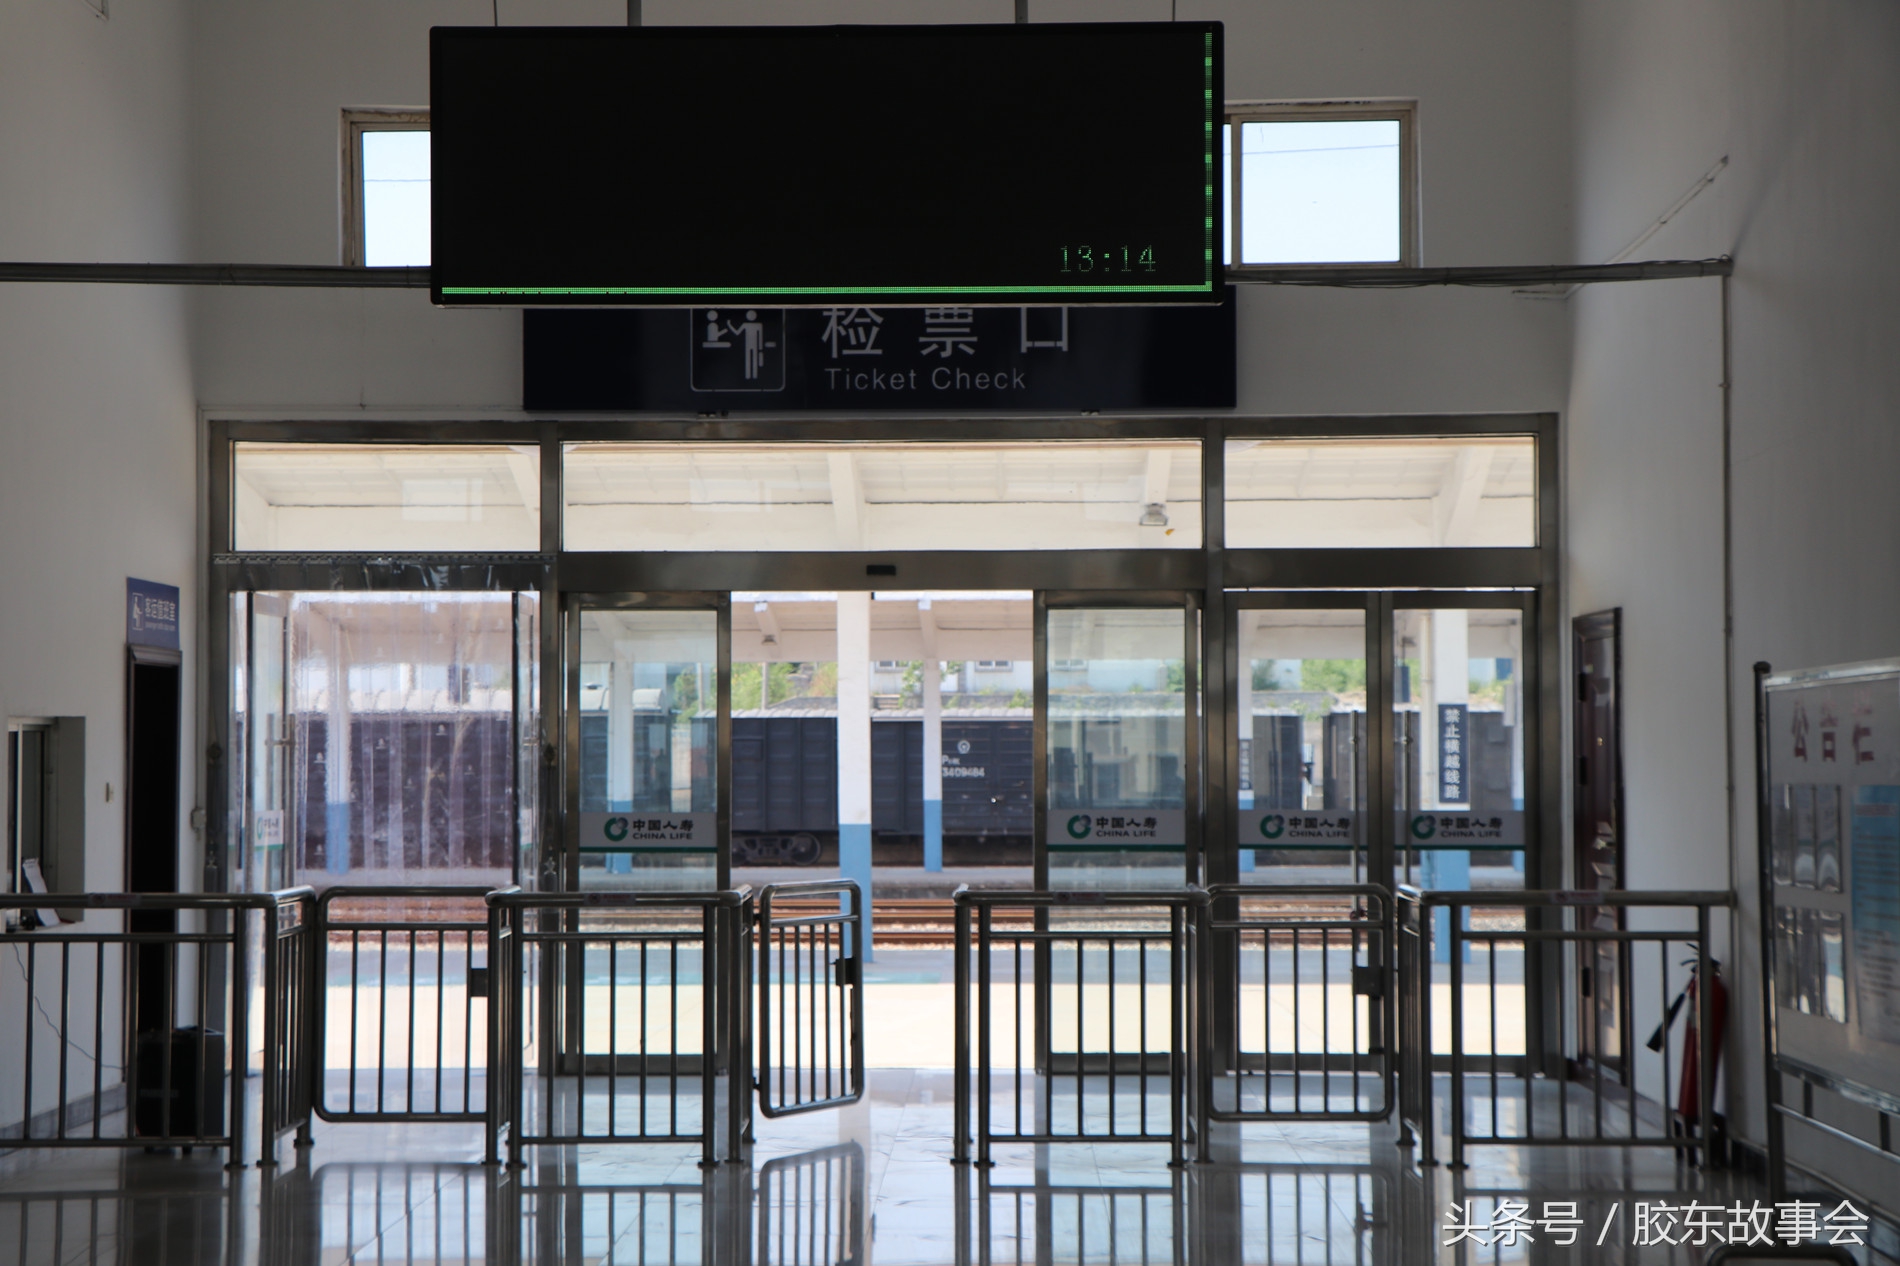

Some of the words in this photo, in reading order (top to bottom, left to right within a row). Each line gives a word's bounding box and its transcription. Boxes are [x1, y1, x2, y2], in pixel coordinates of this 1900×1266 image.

[1059, 244, 1157, 272] 13:14
[821, 307, 1069, 359] 检票口
[825, 366, 918, 391] Ticket
[931, 366, 1027, 391] Check
[1444, 708, 1461, 800] 禁止横越线路
[632, 819, 694, 831] 中国人寿
[1096, 816, 1158, 829] 中国人寿
[1288, 817, 1351, 829] 中国人寿
[1440, 817, 1503, 829] 中国人寿
[632, 832, 666, 840] CHINA
[669, 832, 693, 840] LIFE
[1096, 830, 1130, 838] CHINA
[1133, 830, 1157, 838] LIFE
[1288, 830, 1324, 838] CHINA
[1326, 830, 1350, 838] LIFE
[1440, 830, 1475, 838] CHINA
[1477, 830, 1502, 838] LIFE
